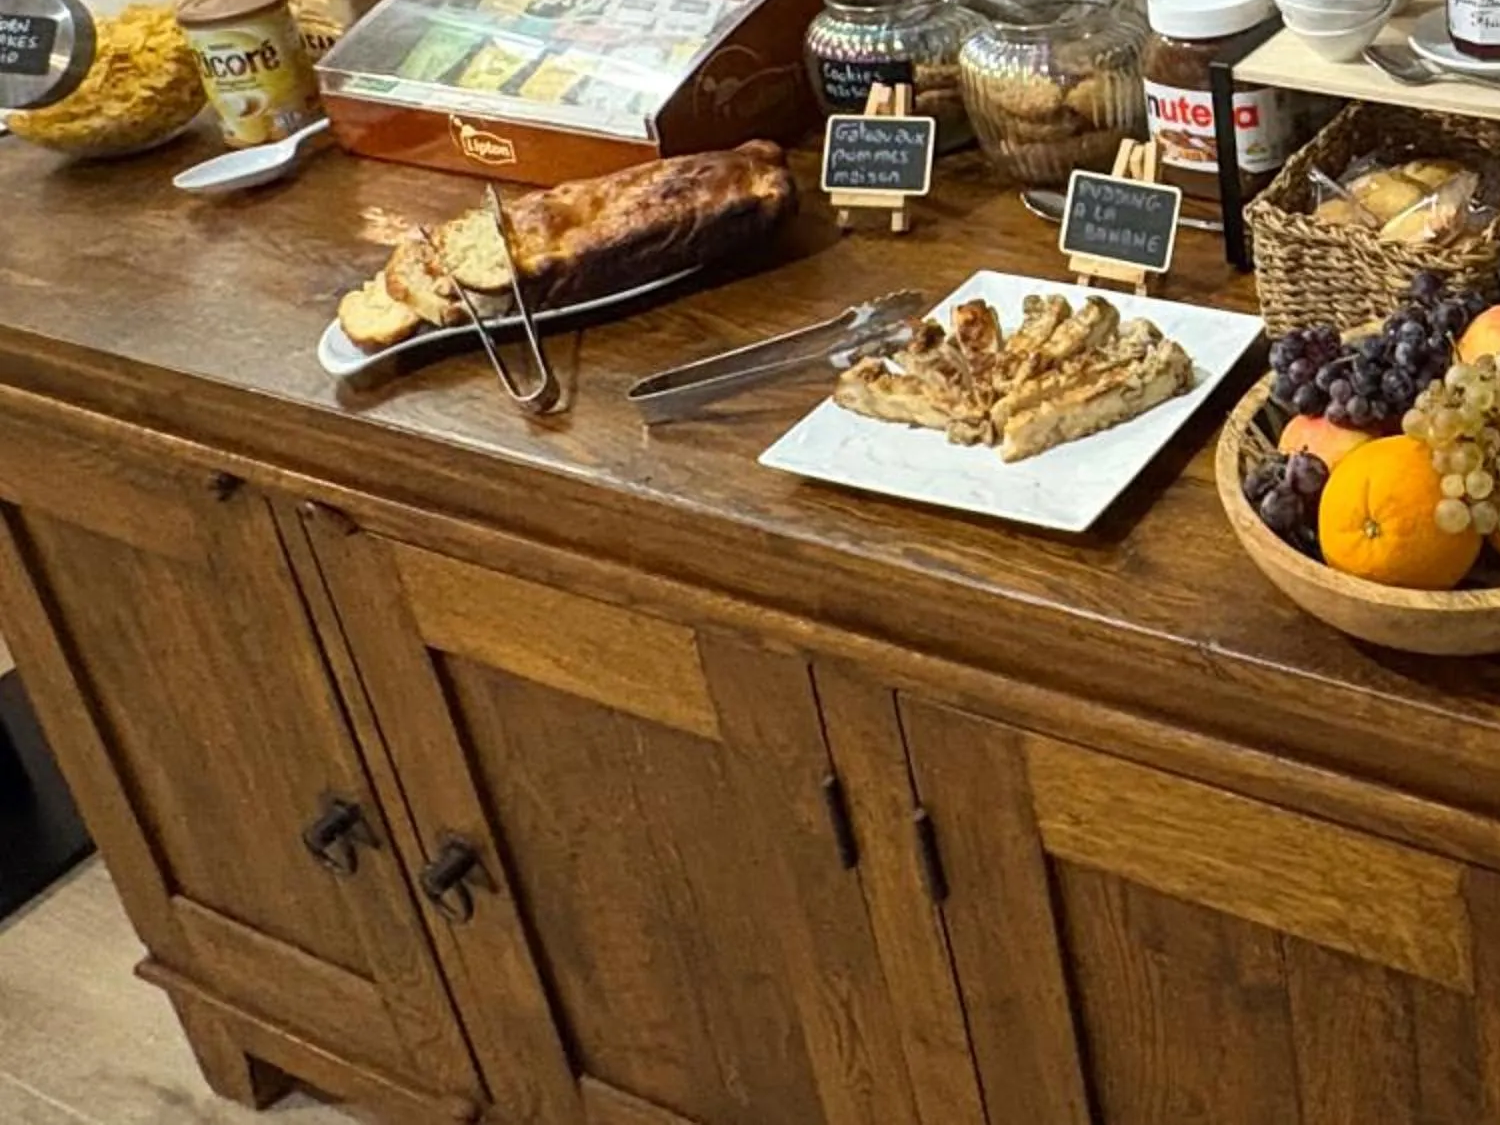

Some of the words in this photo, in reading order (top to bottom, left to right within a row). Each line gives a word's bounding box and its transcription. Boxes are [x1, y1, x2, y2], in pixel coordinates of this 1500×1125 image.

[0, 18, 31, 33] ORN
[0, 33, 39, 49] AKES
[202, 38, 281, 78] icoré
[1147, 94, 1260, 129] nutea
[467, 138, 510, 157] Lipton
[833, 165, 901, 185] maison
